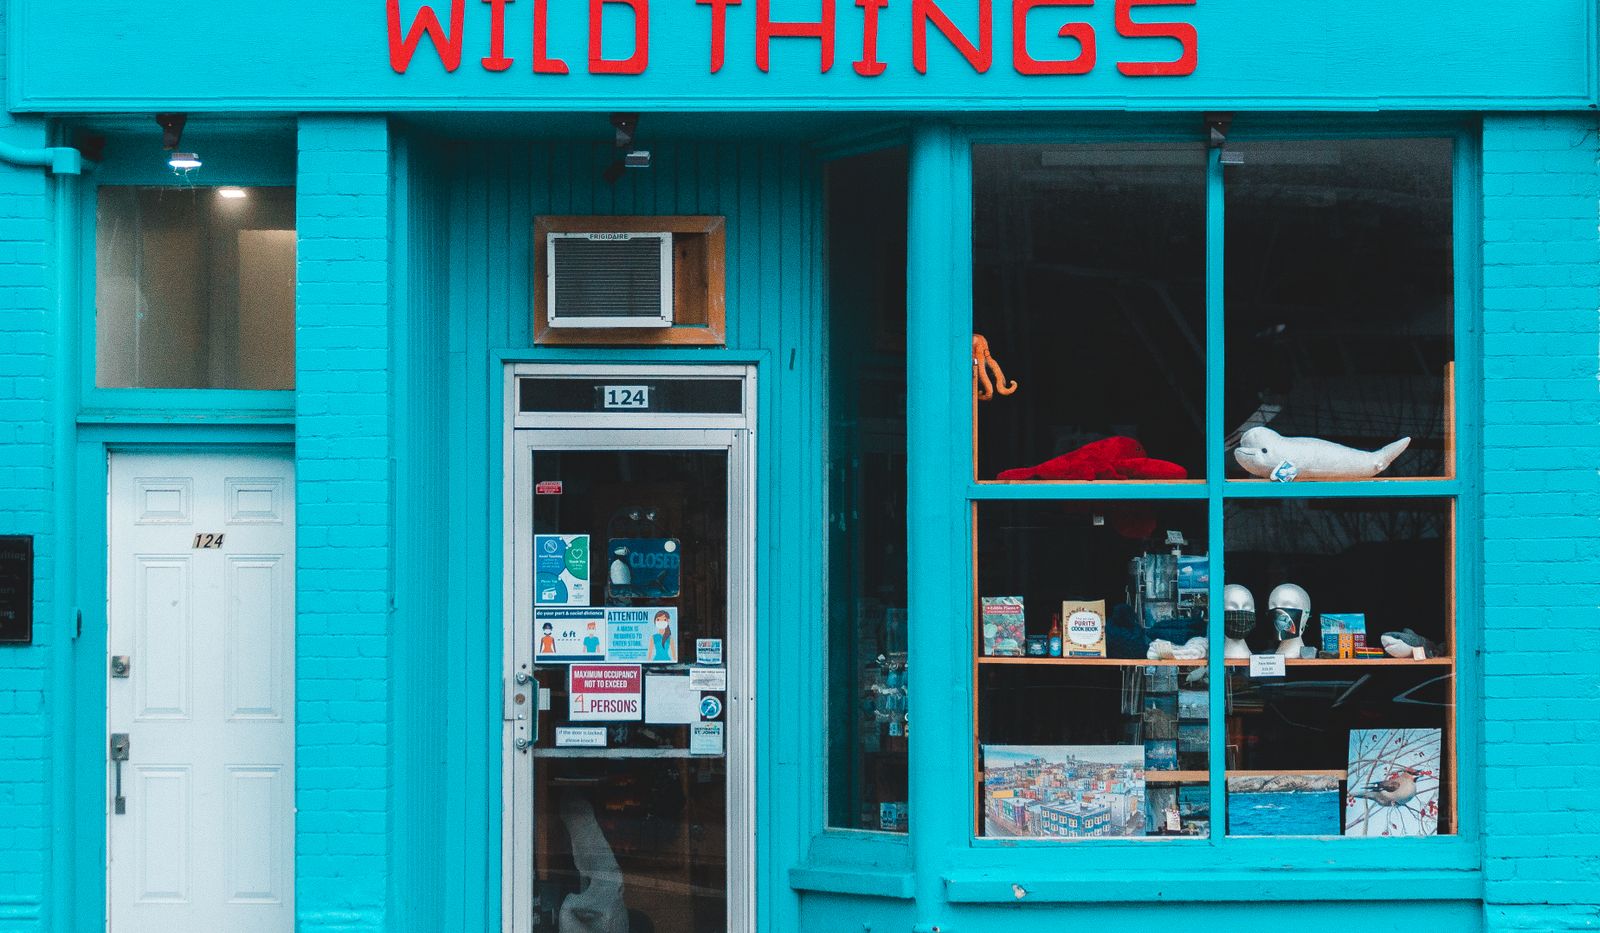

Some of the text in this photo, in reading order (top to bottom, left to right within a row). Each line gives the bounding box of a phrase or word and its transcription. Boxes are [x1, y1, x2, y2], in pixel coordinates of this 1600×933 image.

[386, 0, 1199, 77] WILD THINGS
[607, 389, 646, 406] 124
[195, 533, 225, 549] 124
[630, 551, 679, 569] CLOSED
[607, 610, 649, 622] ATTENTION
[562, 630, 576, 638] 6 ft
[573, 670, 638, 679] MAXIMUM OCCUPANCY
[584, 680, 628, 688] NOT TO EXCEED
[590, 699, 638, 713] PERSONS
